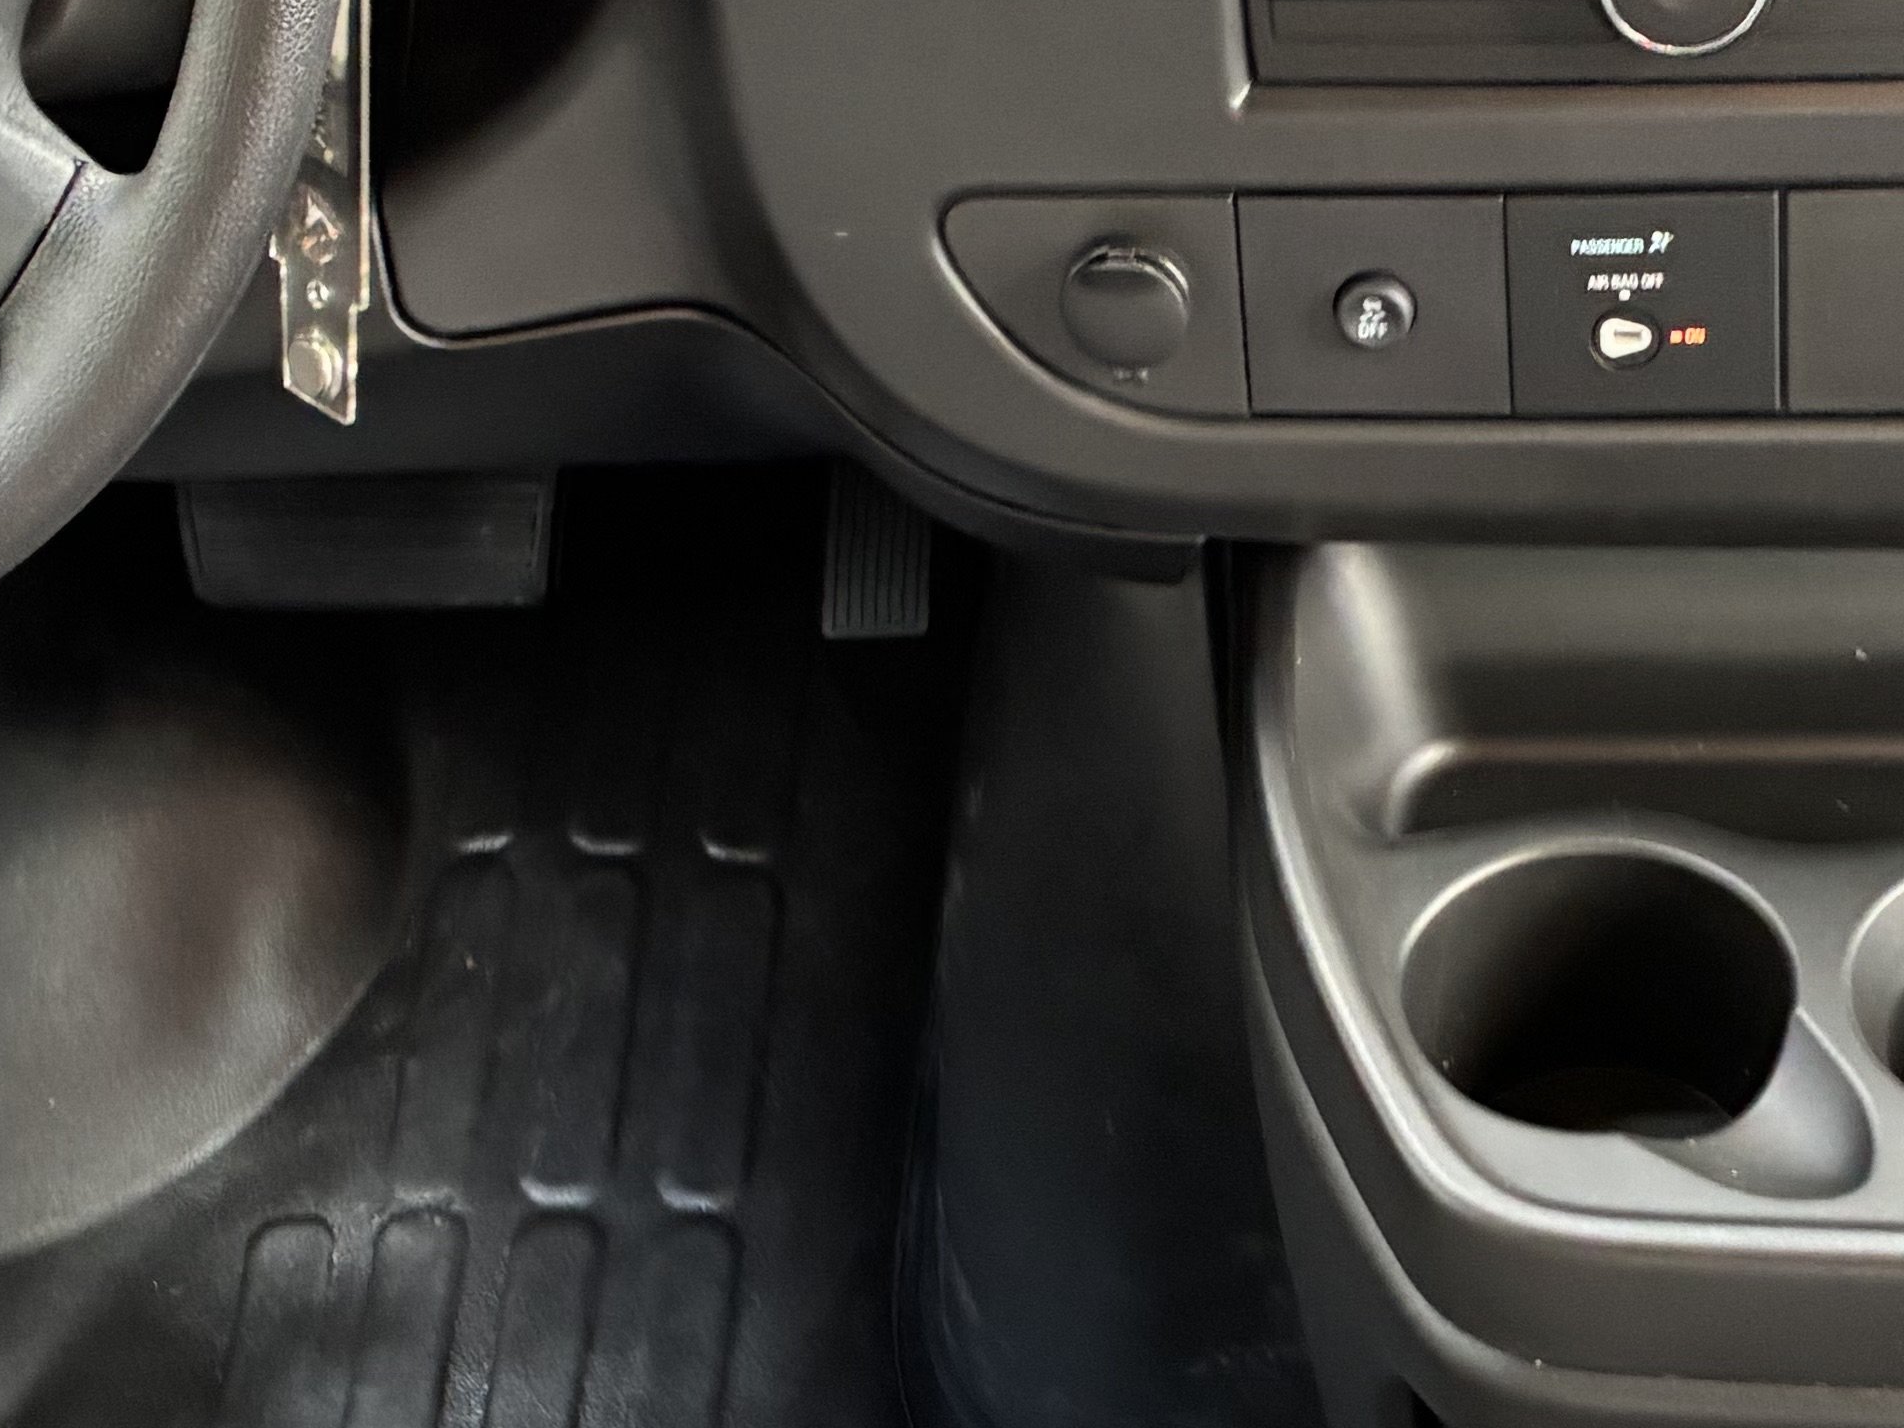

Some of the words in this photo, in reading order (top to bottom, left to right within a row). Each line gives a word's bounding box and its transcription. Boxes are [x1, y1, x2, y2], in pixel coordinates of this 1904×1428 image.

[1571, 237, 1645, 256] PASSENGER
[1587, 274, 1609, 291] AIR
[1611, 273, 1639, 291] BAG
[1641, 272, 1664, 290] OFF
[1685, 327, 1706, 345] ON
